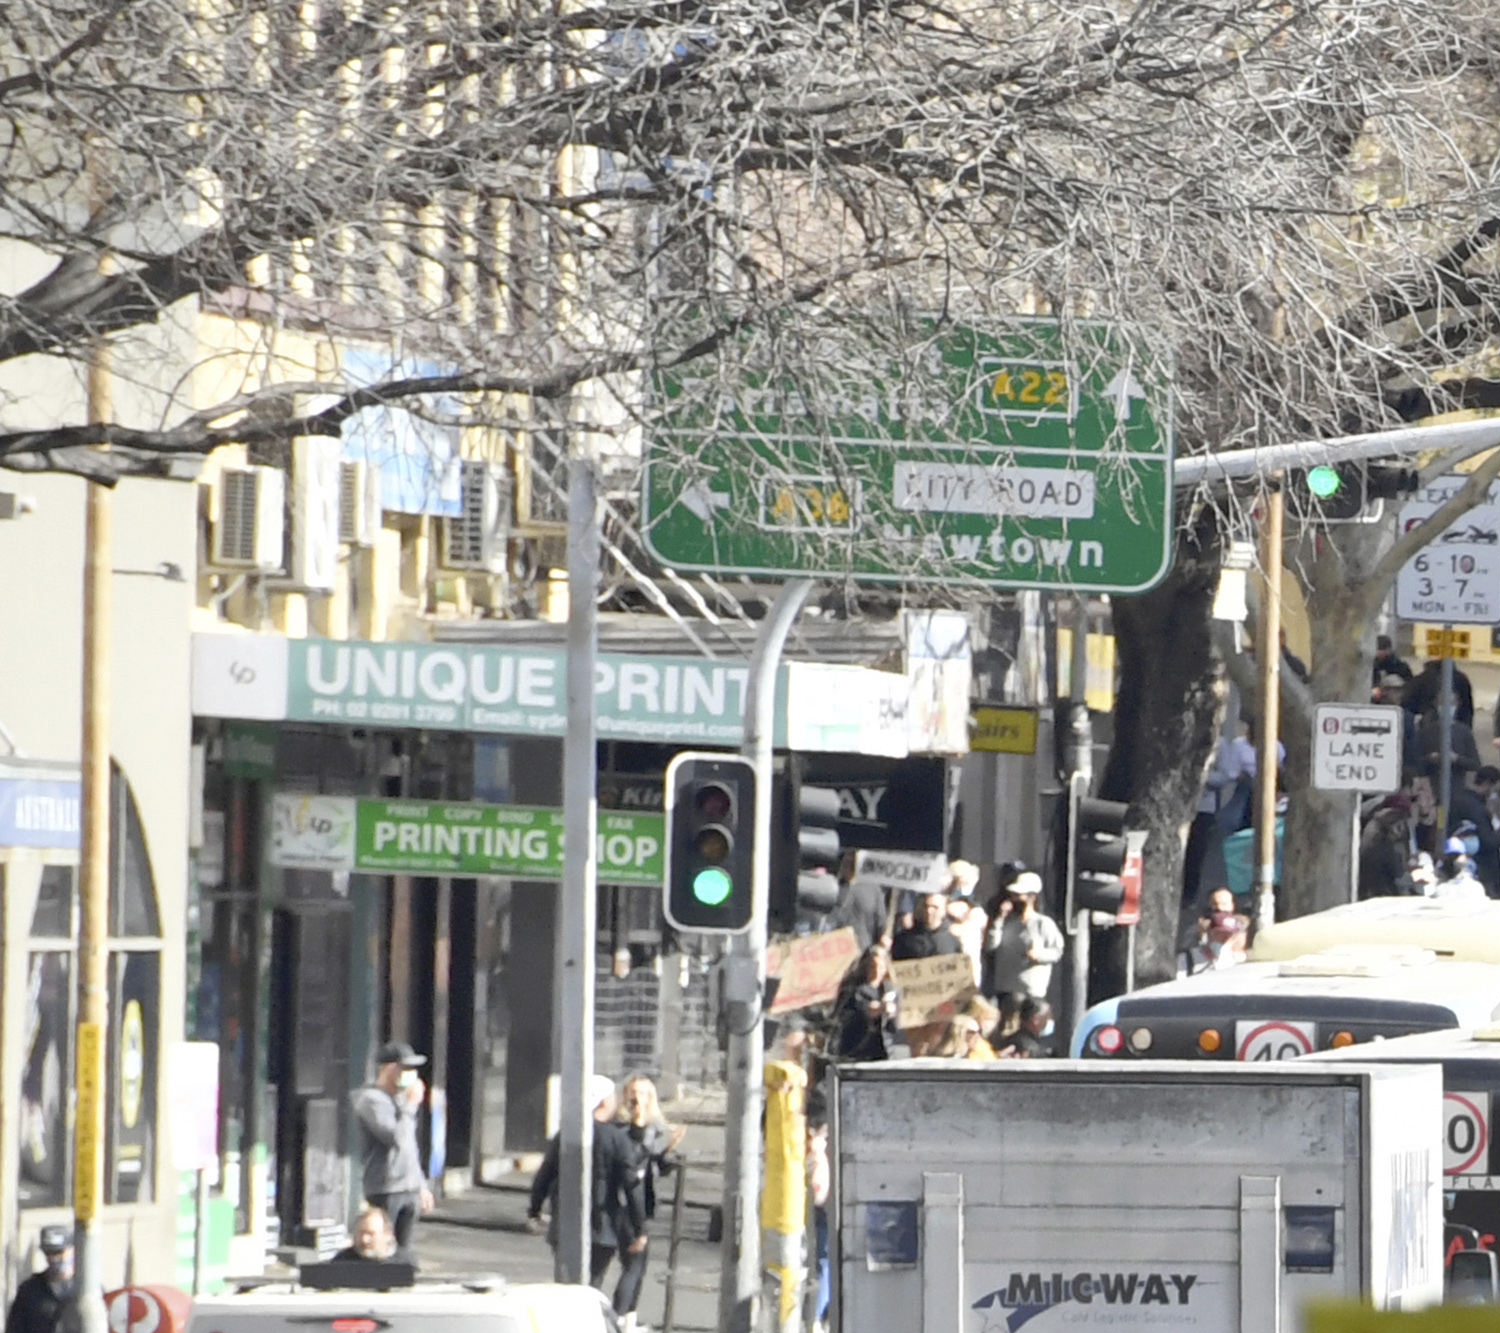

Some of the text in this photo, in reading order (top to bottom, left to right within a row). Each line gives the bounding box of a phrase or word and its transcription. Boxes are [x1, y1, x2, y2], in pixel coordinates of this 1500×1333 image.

[991, 371, 1067, 403] A22
[1005, 478, 1082, 507] ROAD
[1412, 600, 1445, 614] MON
[305, 645, 556, 707] UNIQUE
[1328, 742, 1385, 759] LANE
[1335, 765, 1378, 781] END
[374, 822, 548, 860] PRINTING
[1006, 1273, 1197, 1304] MICWAY
[1062, 1311, 1198, 1326] Cold Logistic Solutions
